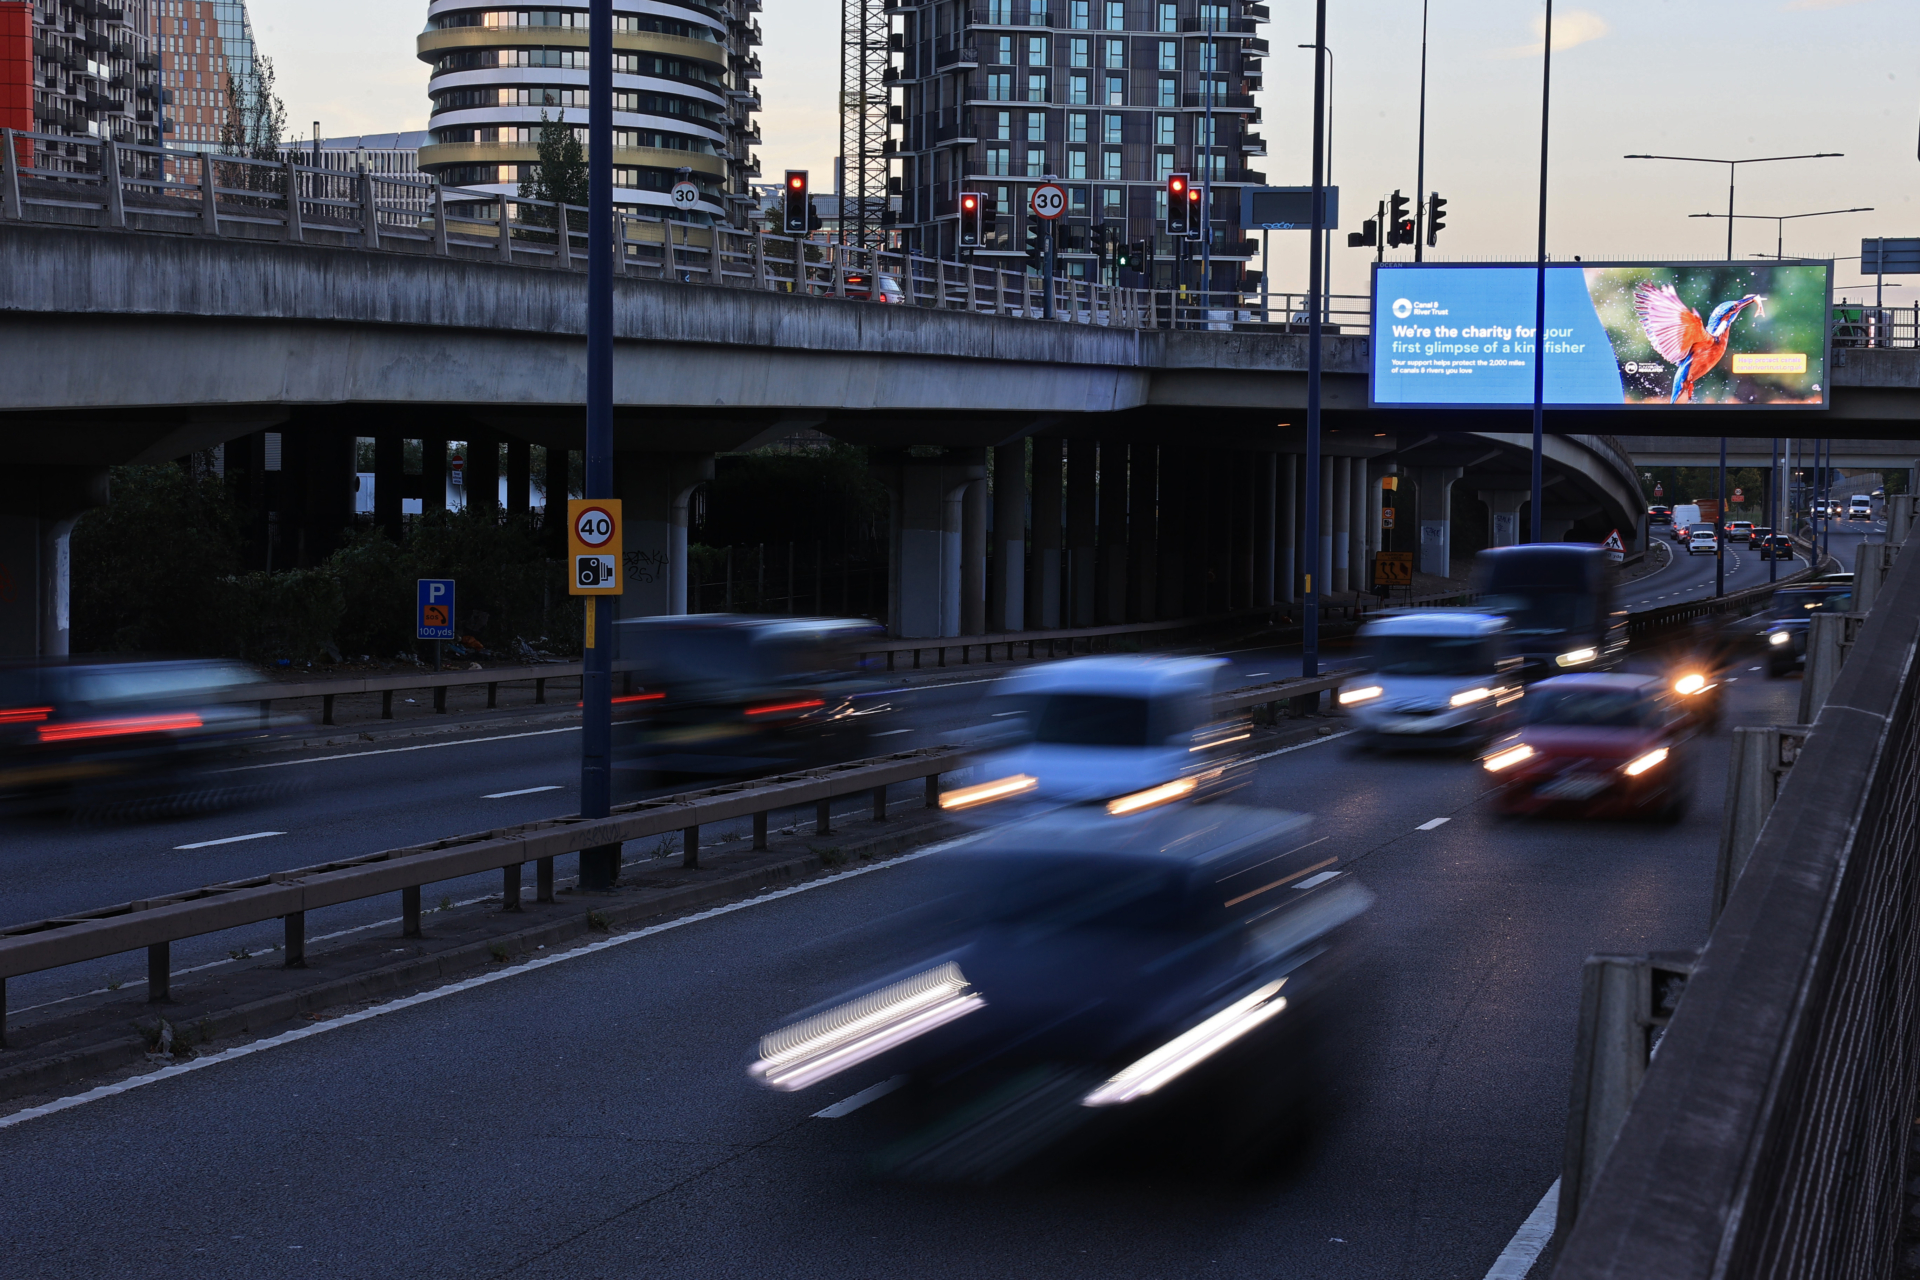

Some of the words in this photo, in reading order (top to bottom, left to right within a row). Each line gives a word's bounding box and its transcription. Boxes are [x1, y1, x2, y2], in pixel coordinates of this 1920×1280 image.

[676, 189, 695, 202] 30
[1036, 193, 1062, 209] 30
[1434, 325, 1458, 338] the
[1461, 325, 1512, 340] charity
[1515, 325, 1537, 338] for
[1543, 328, 1573, 340] your
[1392, 341, 1421, 353] first
[1424, 341, 1479, 356] glimpse
[1483, 341, 1499, 353] of
[1502, 344, 1510, 353] a
[1433, 359, 1451, 367] helps
[1452, 359, 1476, 367] protect
[1489, 359, 1508, 367] 2,000
[580, 519, 610, 536] 40
[429, 583, 445, 603] P
[419, 628, 436, 636] 100
[437, 628, 452, 637] yds
